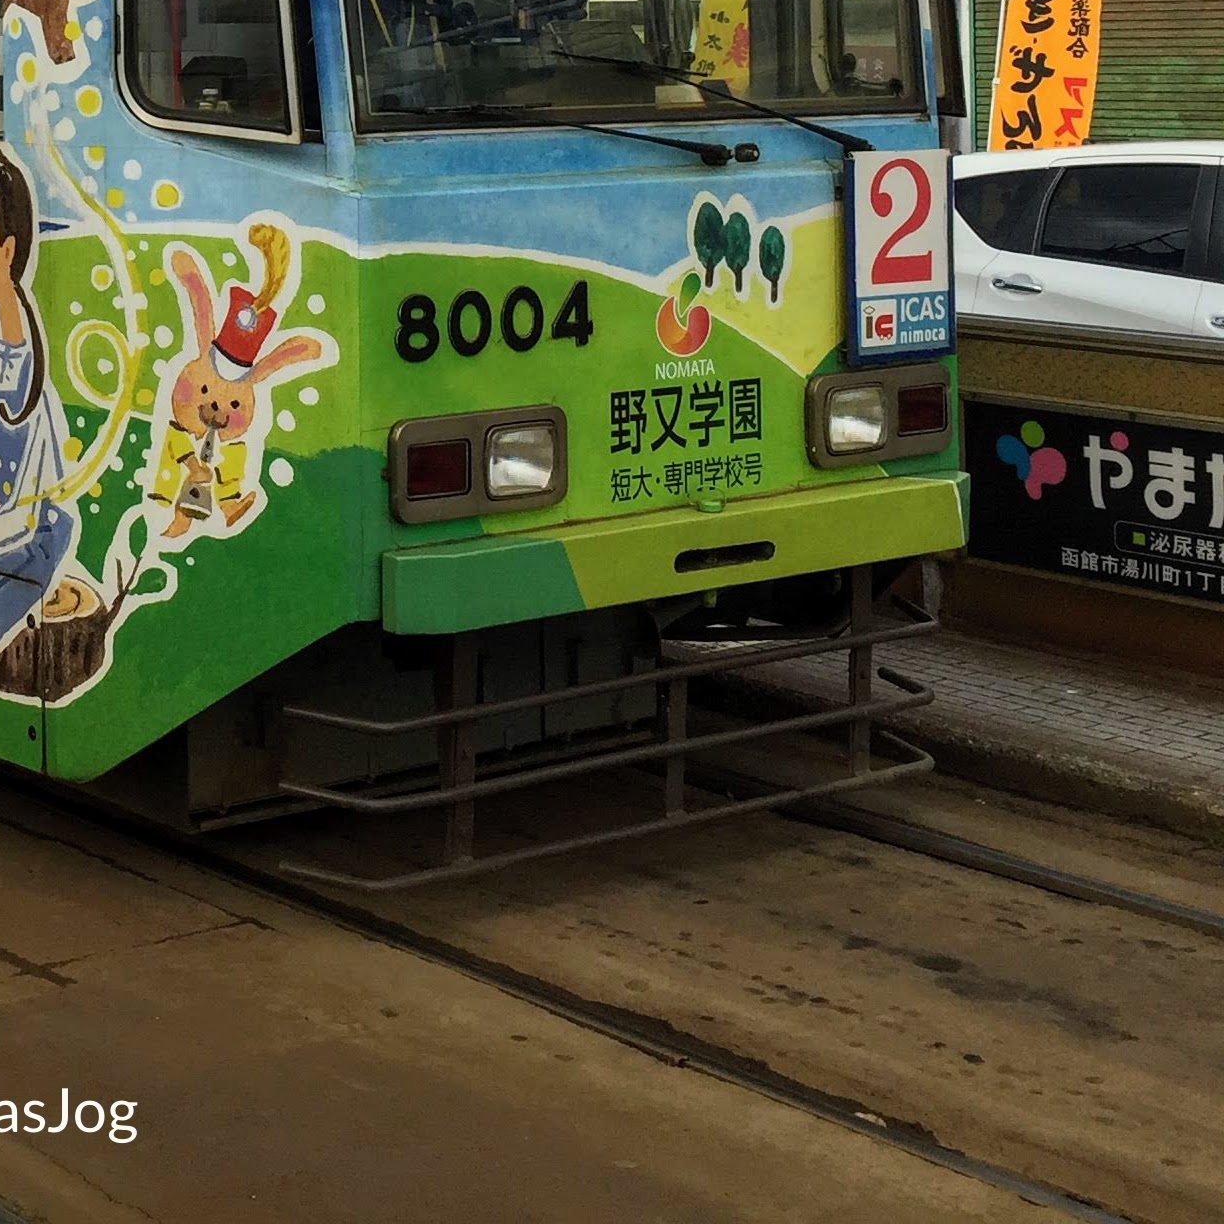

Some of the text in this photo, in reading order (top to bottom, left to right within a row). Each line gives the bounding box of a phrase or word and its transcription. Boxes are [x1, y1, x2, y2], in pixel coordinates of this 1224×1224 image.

[870, 158, 933, 285] 2
[394, 280, 594, 363] 8004
[900, 294, 946, 323] ICAS
[900, 326, 946, 345] nimoca
[654, 358, 715, 381] NOMATA
[609, 377, 763, 455] 野又学園
[610, 452, 763, 504] 短大・専門学校号
[1060, 545, 1224, 595] 函館市湯川町1丁
